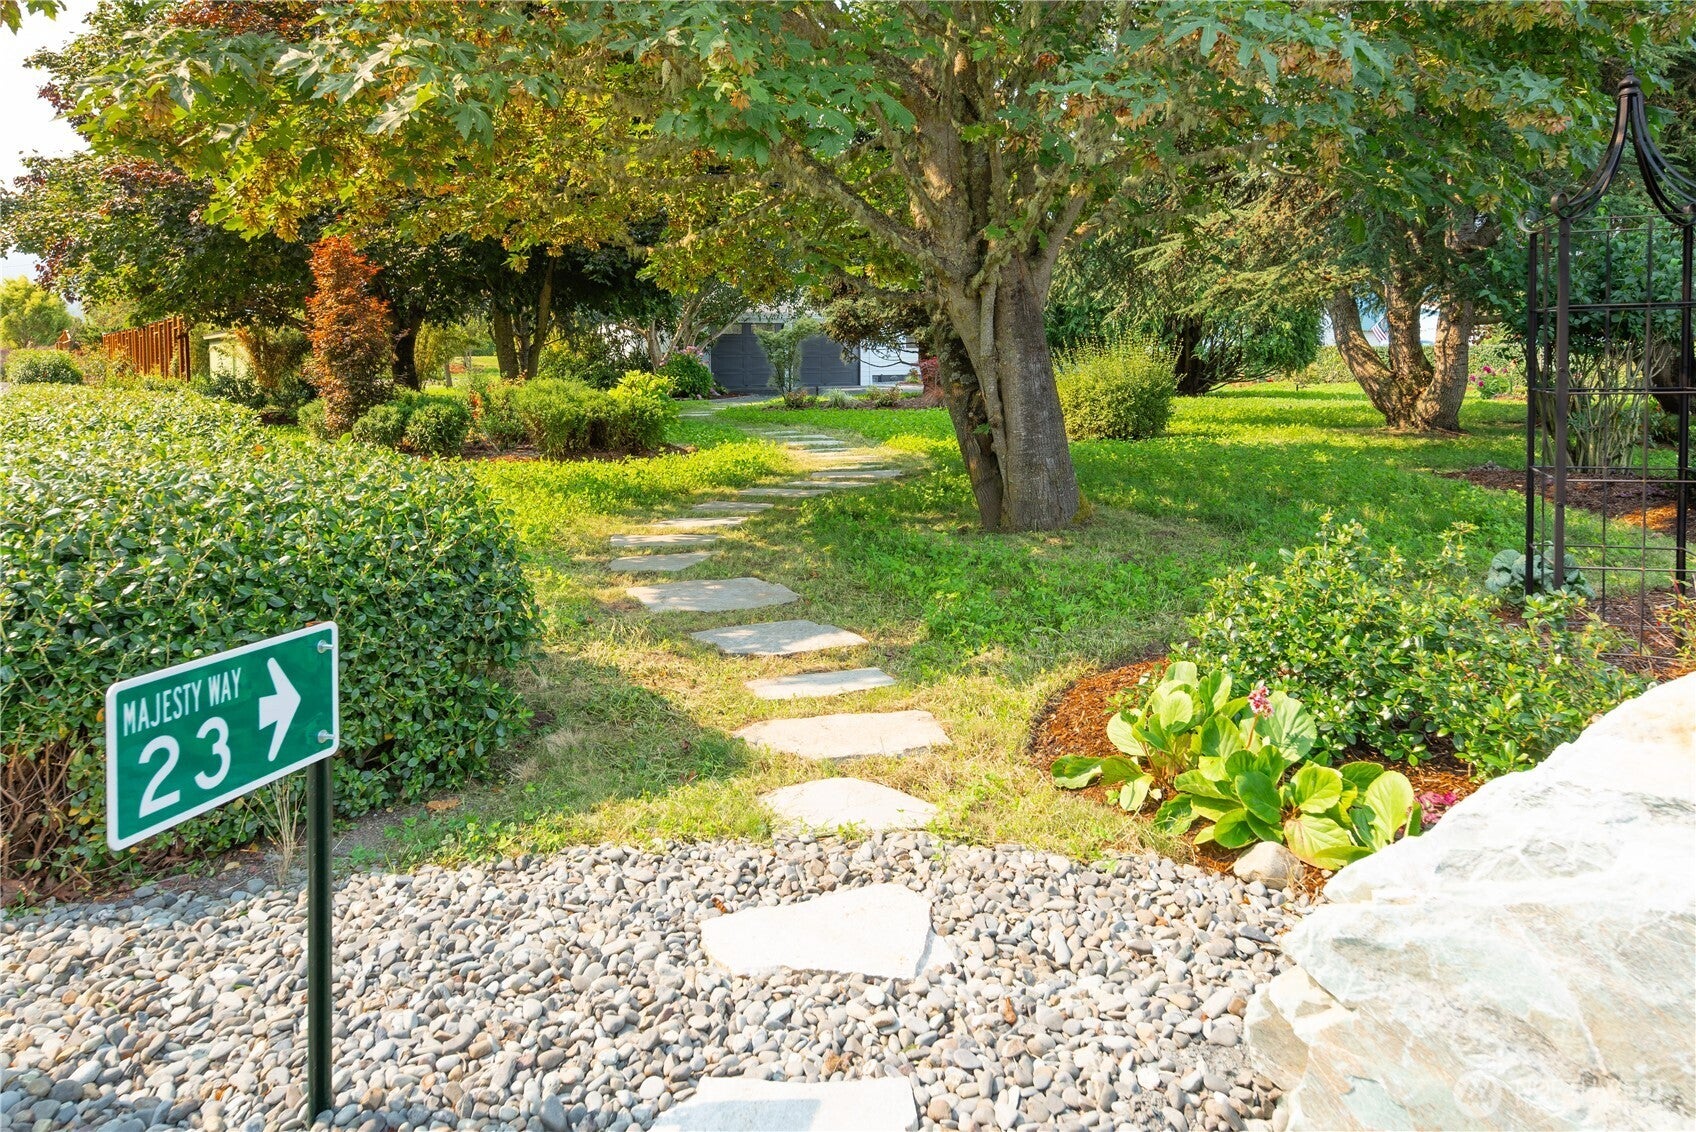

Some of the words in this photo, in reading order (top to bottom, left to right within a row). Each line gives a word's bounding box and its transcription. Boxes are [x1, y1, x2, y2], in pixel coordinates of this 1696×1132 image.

[122, 679, 202, 737] MAJESTY
[208, 667, 242, 707] WAY
[138, 716, 231, 819] 23
